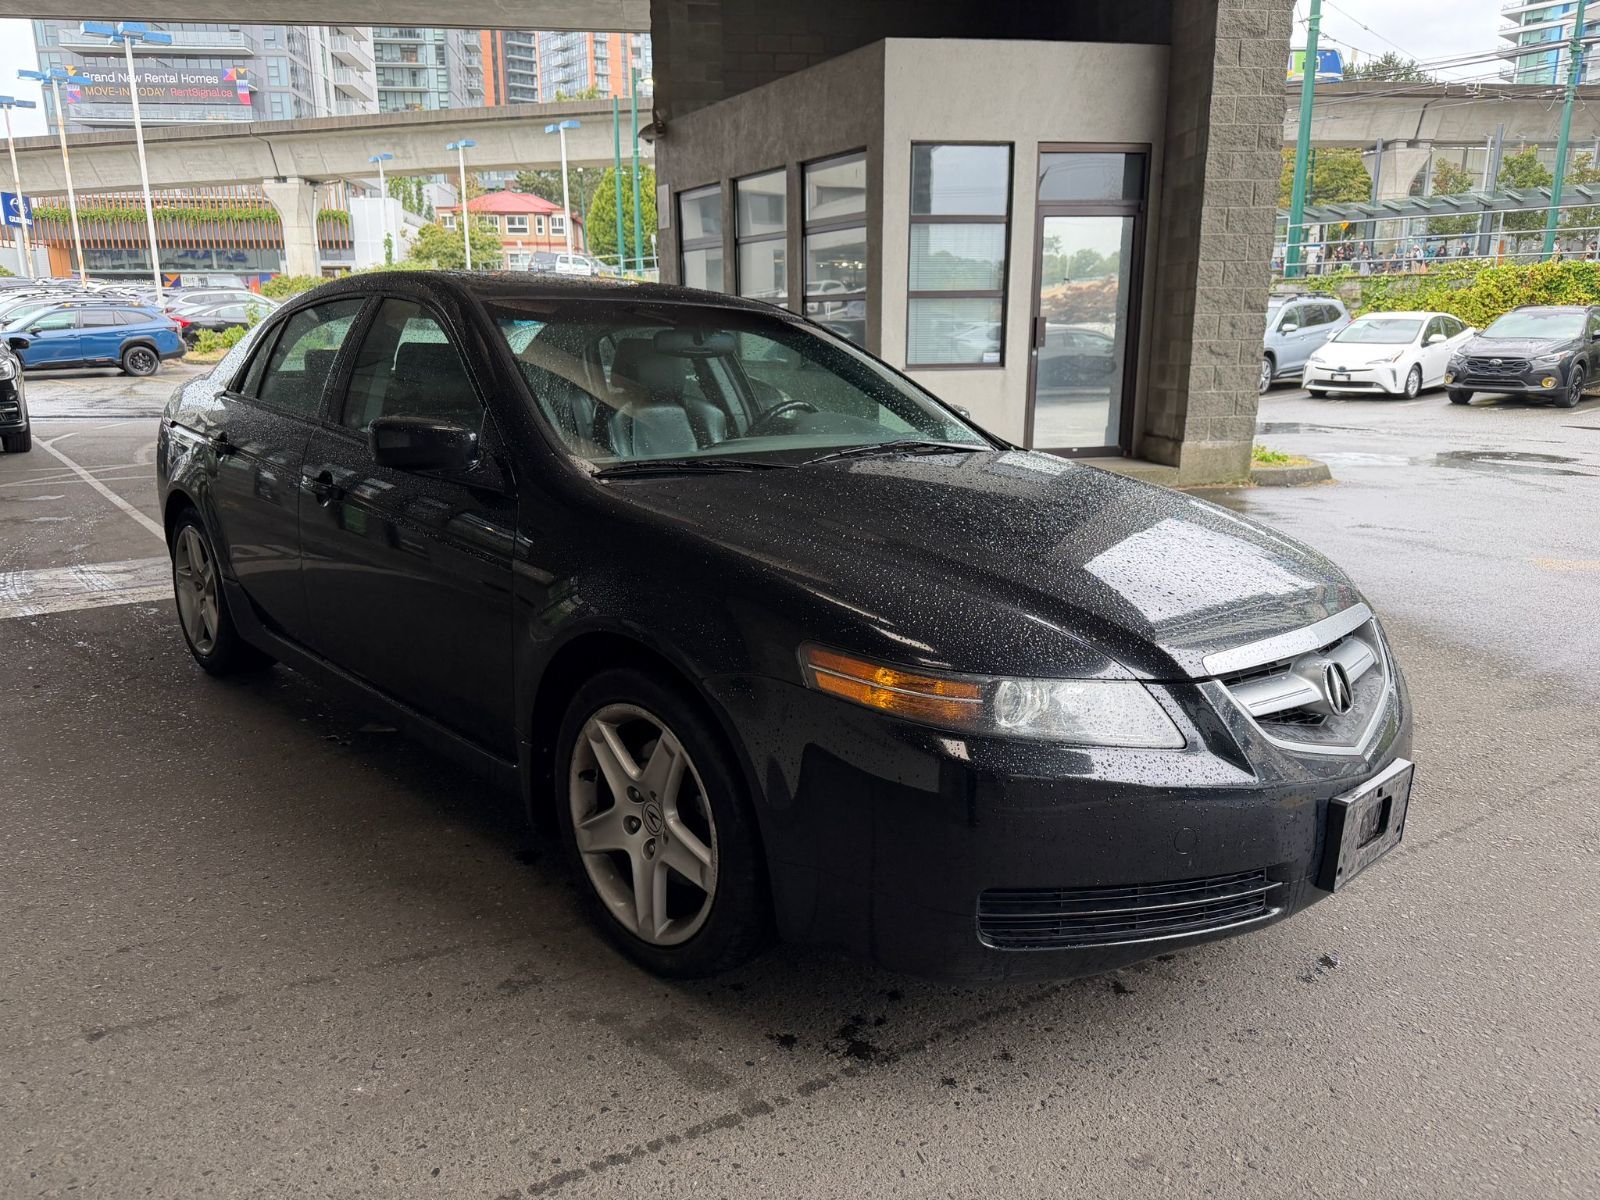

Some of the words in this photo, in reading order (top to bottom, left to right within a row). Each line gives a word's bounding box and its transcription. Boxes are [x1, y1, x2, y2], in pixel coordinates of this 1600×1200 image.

[82, 72, 115, 83] Brand
[144, 73, 178, 83] Rental
[181, 74, 219, 84] Homes
[85, 86, 130, 96] MOVE-IN
[136, 87, 166, 97] ODAY
[170, 87, 233, 98] RentSignal.ca
